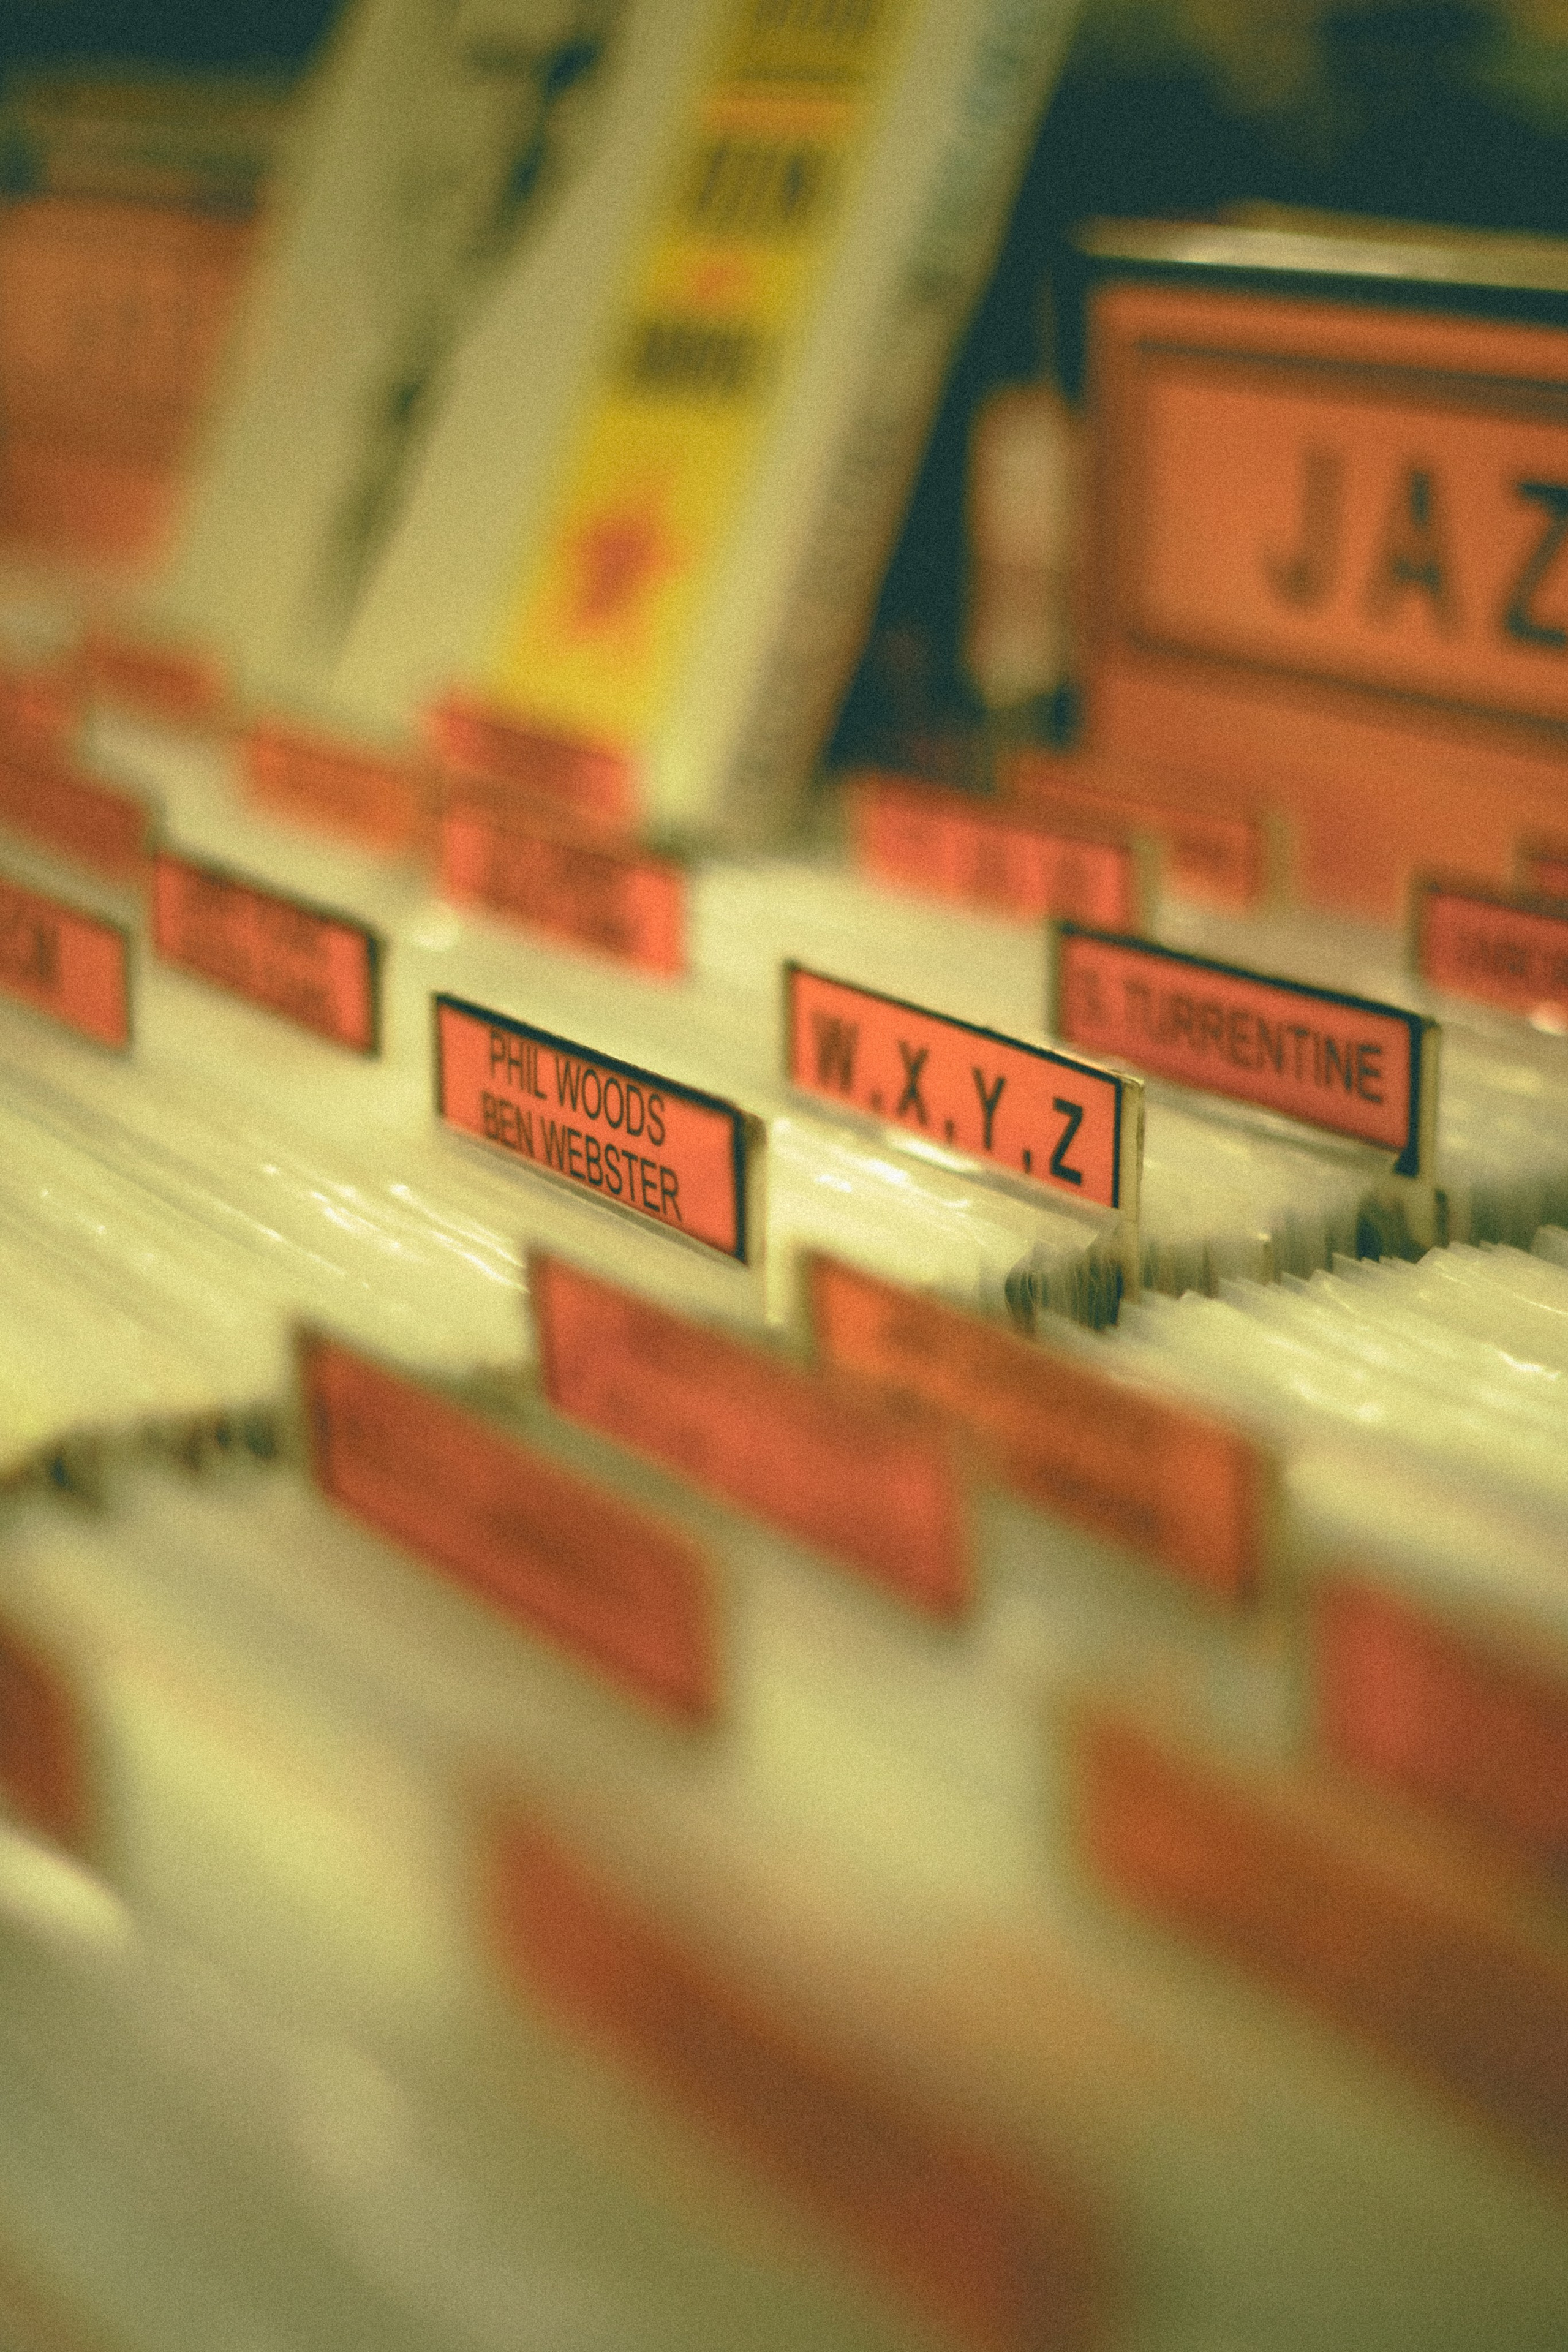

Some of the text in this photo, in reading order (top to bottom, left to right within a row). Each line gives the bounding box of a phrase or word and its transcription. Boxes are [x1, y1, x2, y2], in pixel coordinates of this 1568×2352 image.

[489, 1030, 665, 1147] PHIL WOODS
[1123, 979, 1384, 1104] TURRENTINE
[481, 1090, 682, 1223] BEN WEBSTER
